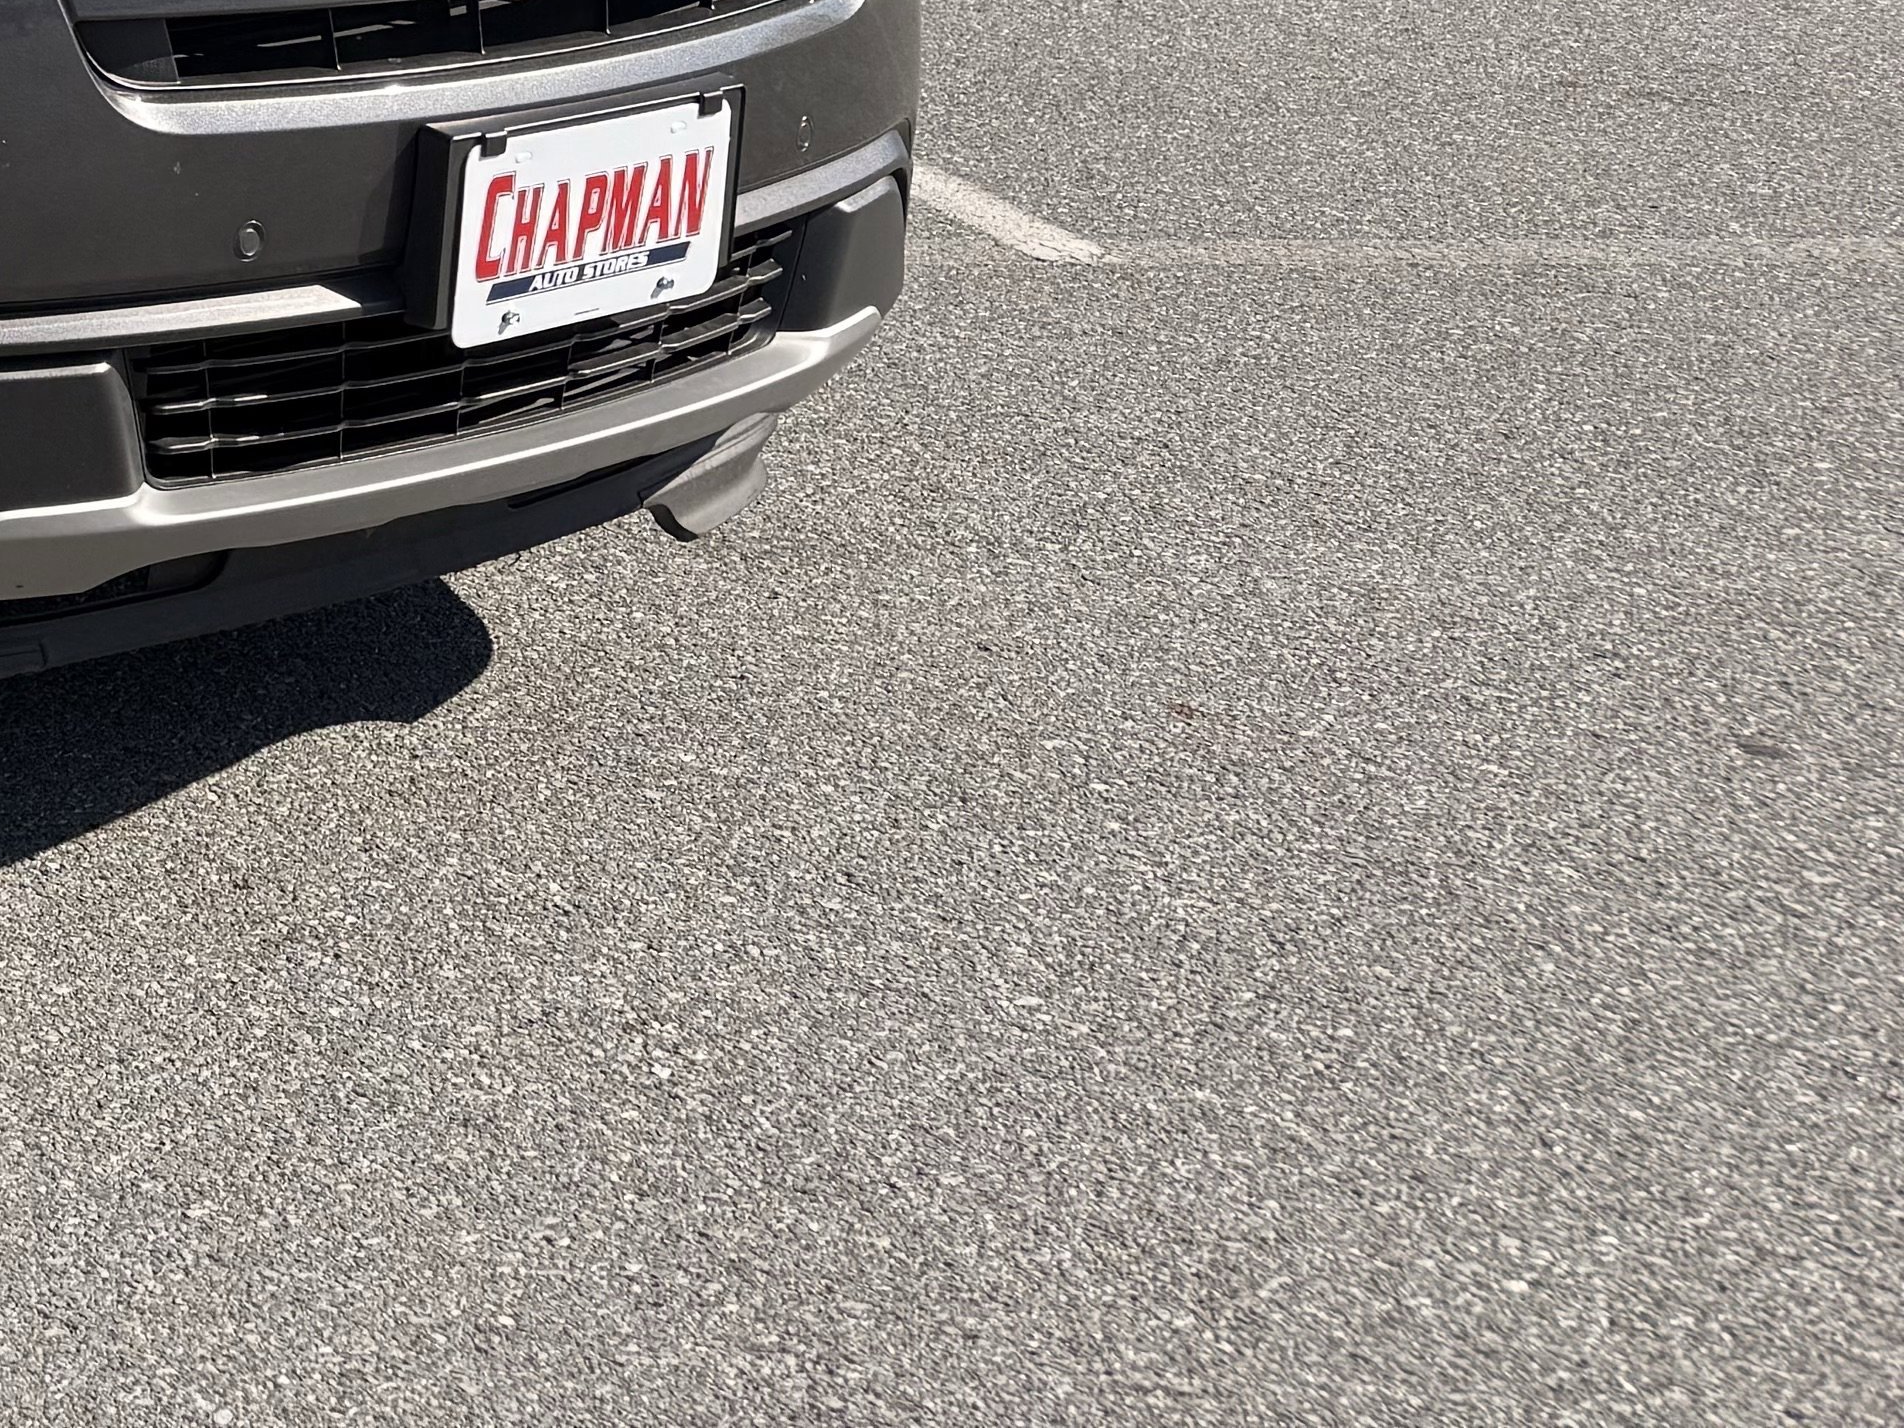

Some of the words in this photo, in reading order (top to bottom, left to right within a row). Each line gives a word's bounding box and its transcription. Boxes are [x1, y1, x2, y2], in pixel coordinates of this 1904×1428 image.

[475, 146, 715, 283] CHAPMAN
[528, 266, 579, 292] AUTO
[582, 250, 651, 279] STORES
